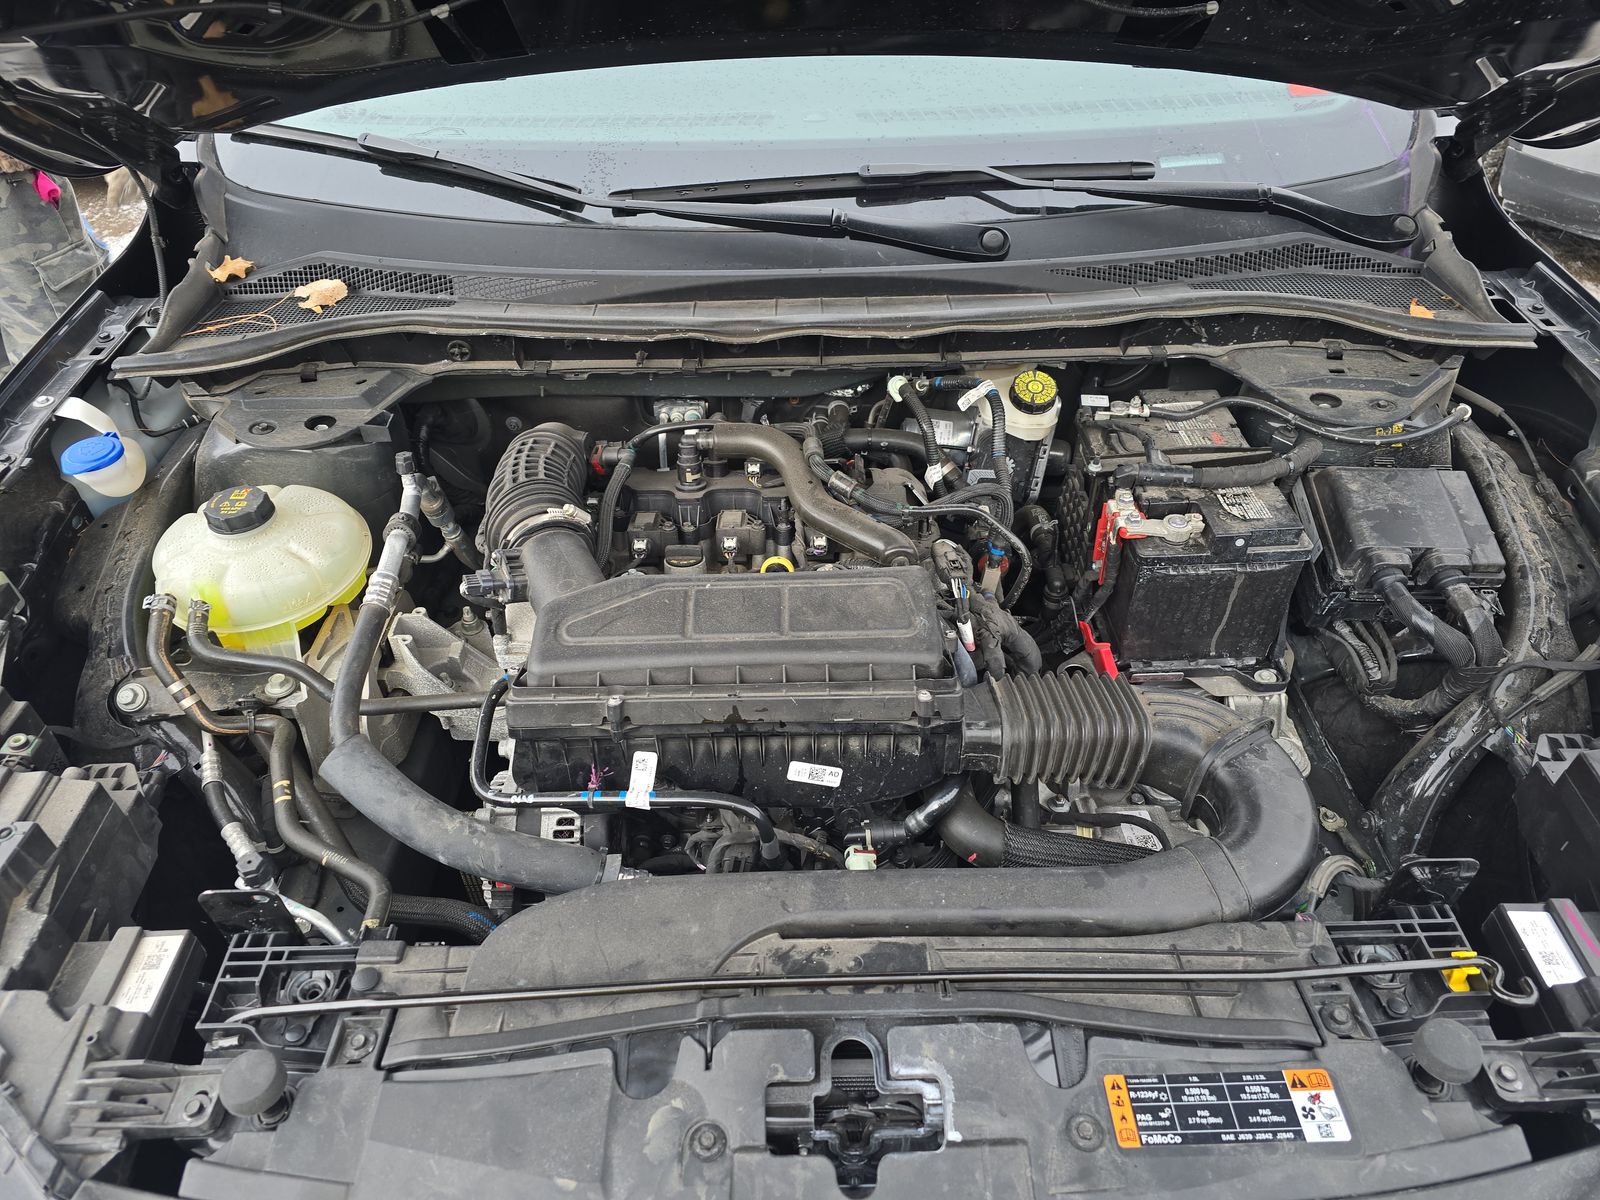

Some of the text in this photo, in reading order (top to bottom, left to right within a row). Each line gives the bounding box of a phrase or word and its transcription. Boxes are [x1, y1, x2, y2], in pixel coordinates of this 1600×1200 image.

[1129, 1090, 1158, 1100] R-1234yf
[1136, 1113, 1152, 1121] PAG
[1196, 1109, 1210, 1117] PAG
[1141, 1134, 1182, 1145] FoMoCo
